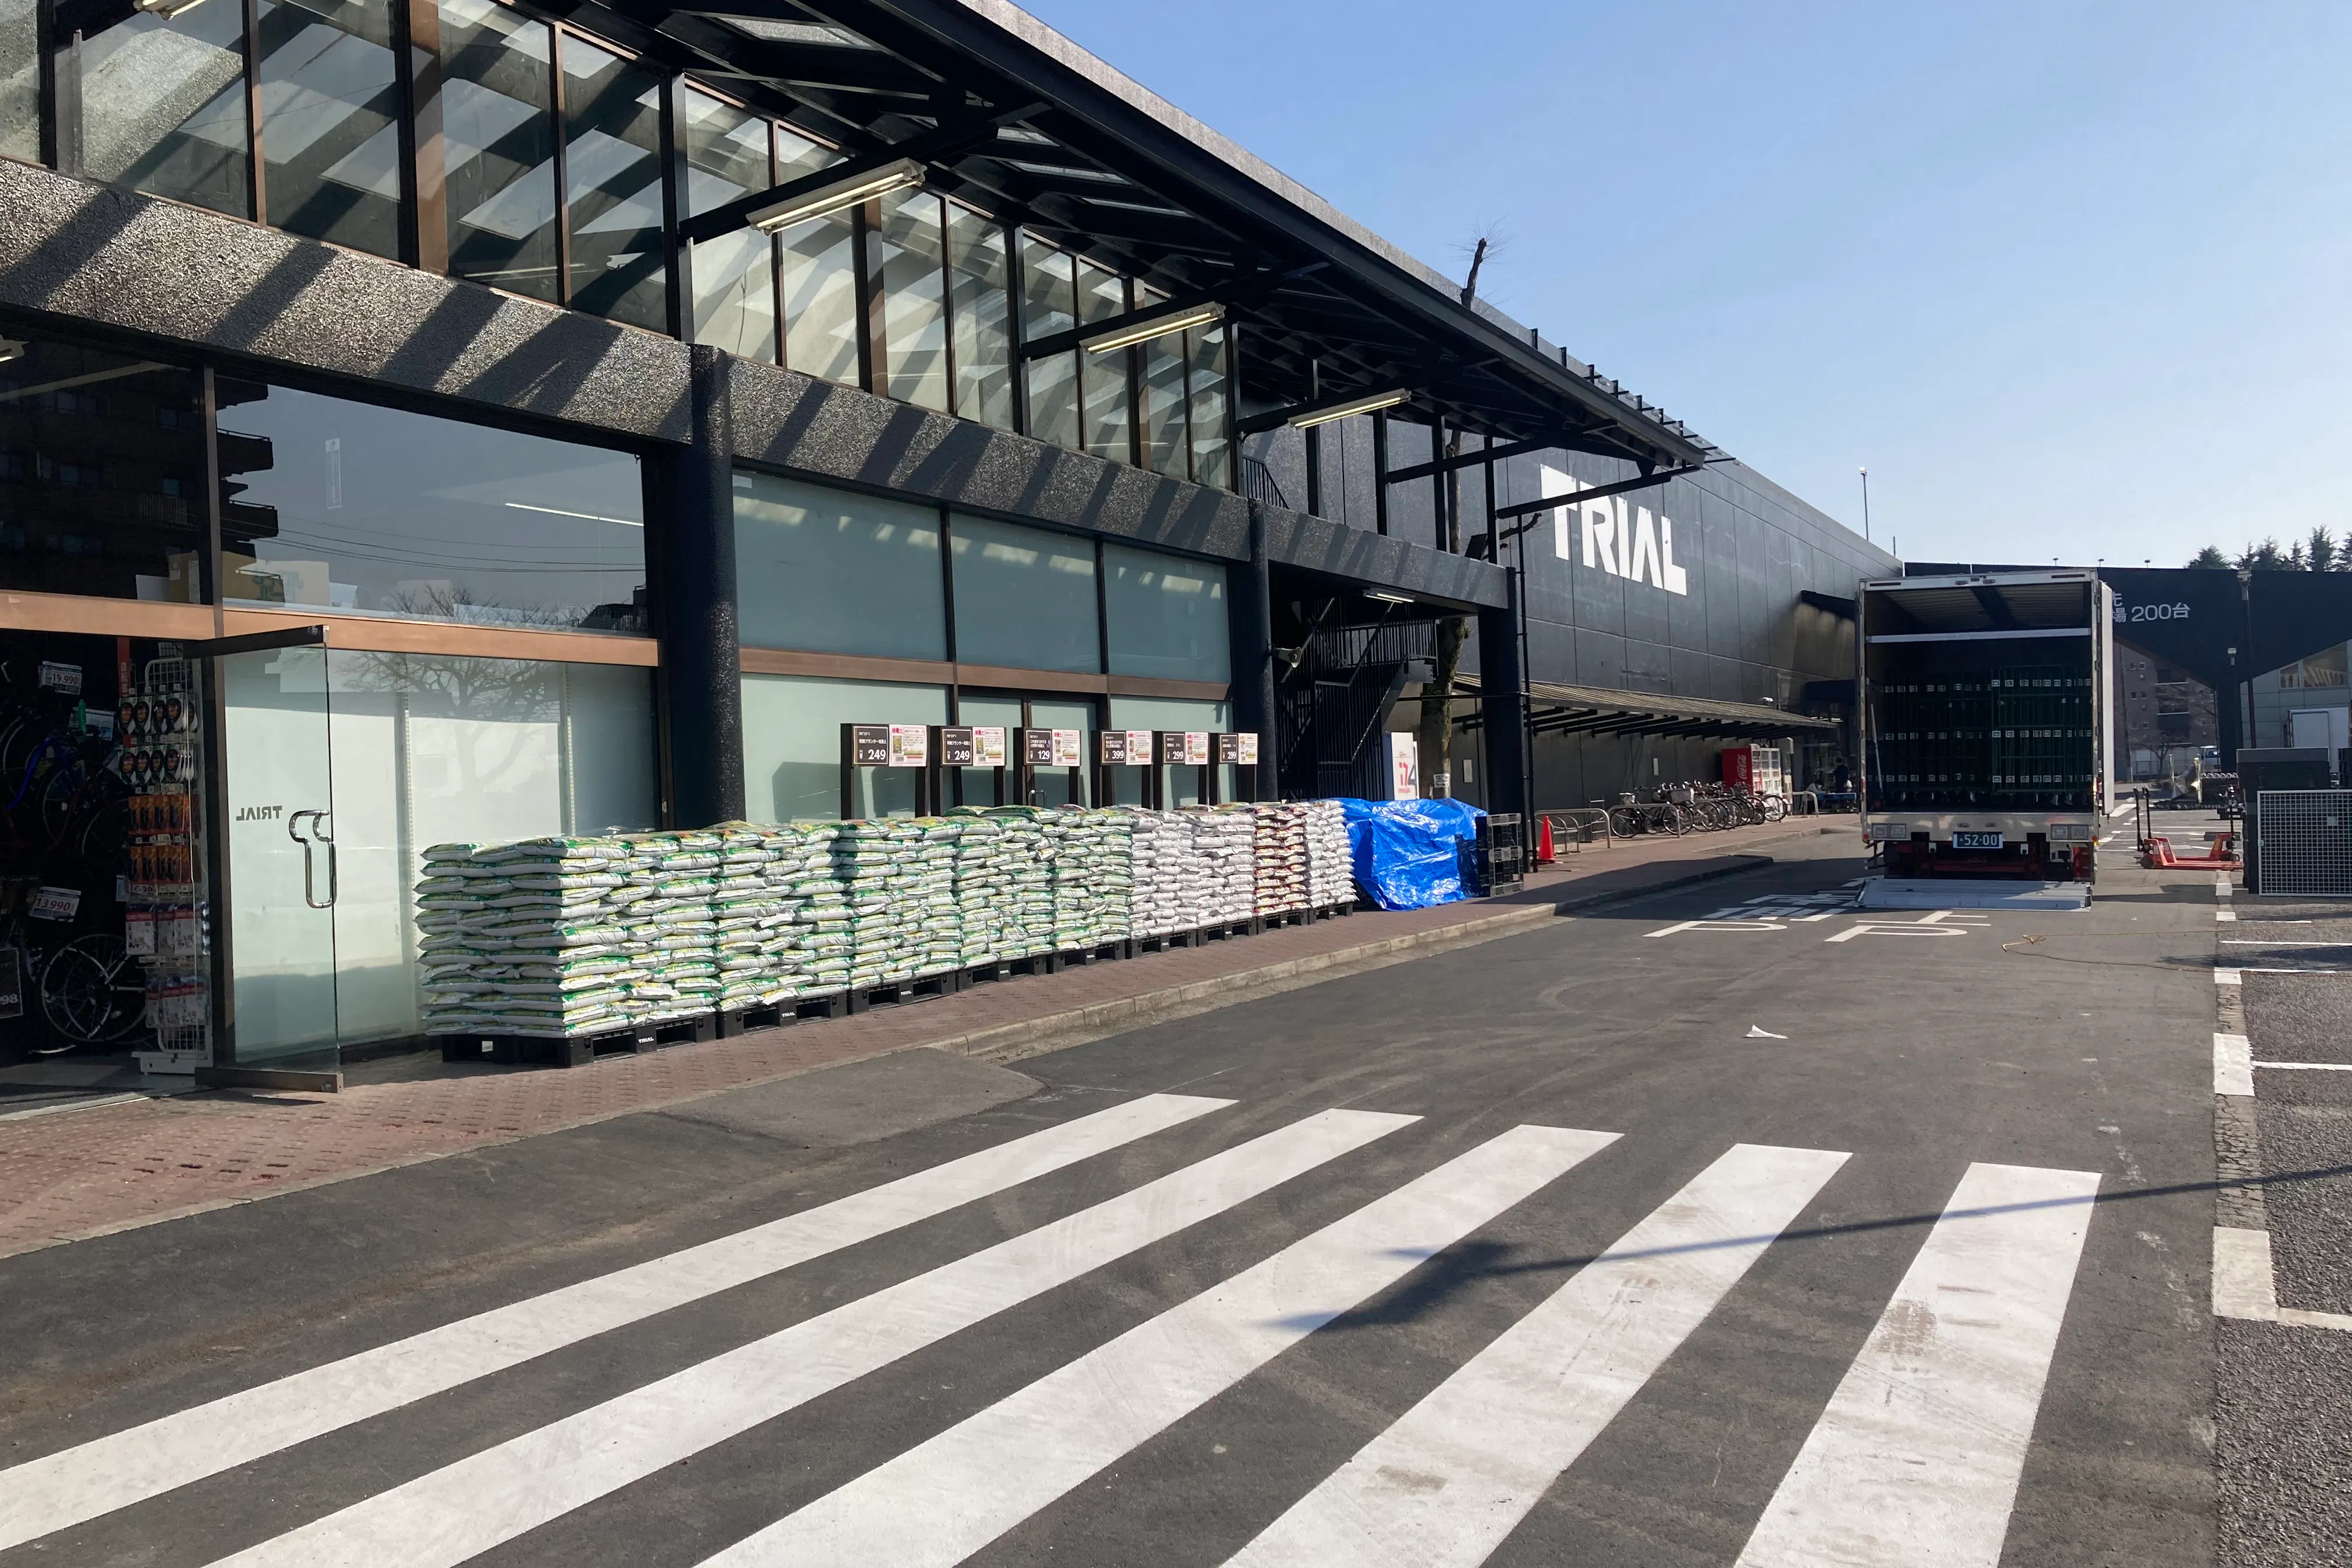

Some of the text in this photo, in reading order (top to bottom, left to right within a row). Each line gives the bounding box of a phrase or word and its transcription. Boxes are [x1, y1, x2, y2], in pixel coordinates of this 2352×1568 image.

[1540, 463, 1687, 596] TRIAL
[2131, 602, 2191, 622] 200台
[868, 749, 886, 760] 249
[954, 750, 970, 761] 249
[1038, 750, 1050, 760] 129
[1112, 750, 1124, 760] 399
[1172, 751, 1184, 760] 299
[1964, 834, 1997, 846] 52-00
[0, 993, 19, 1005] 98
